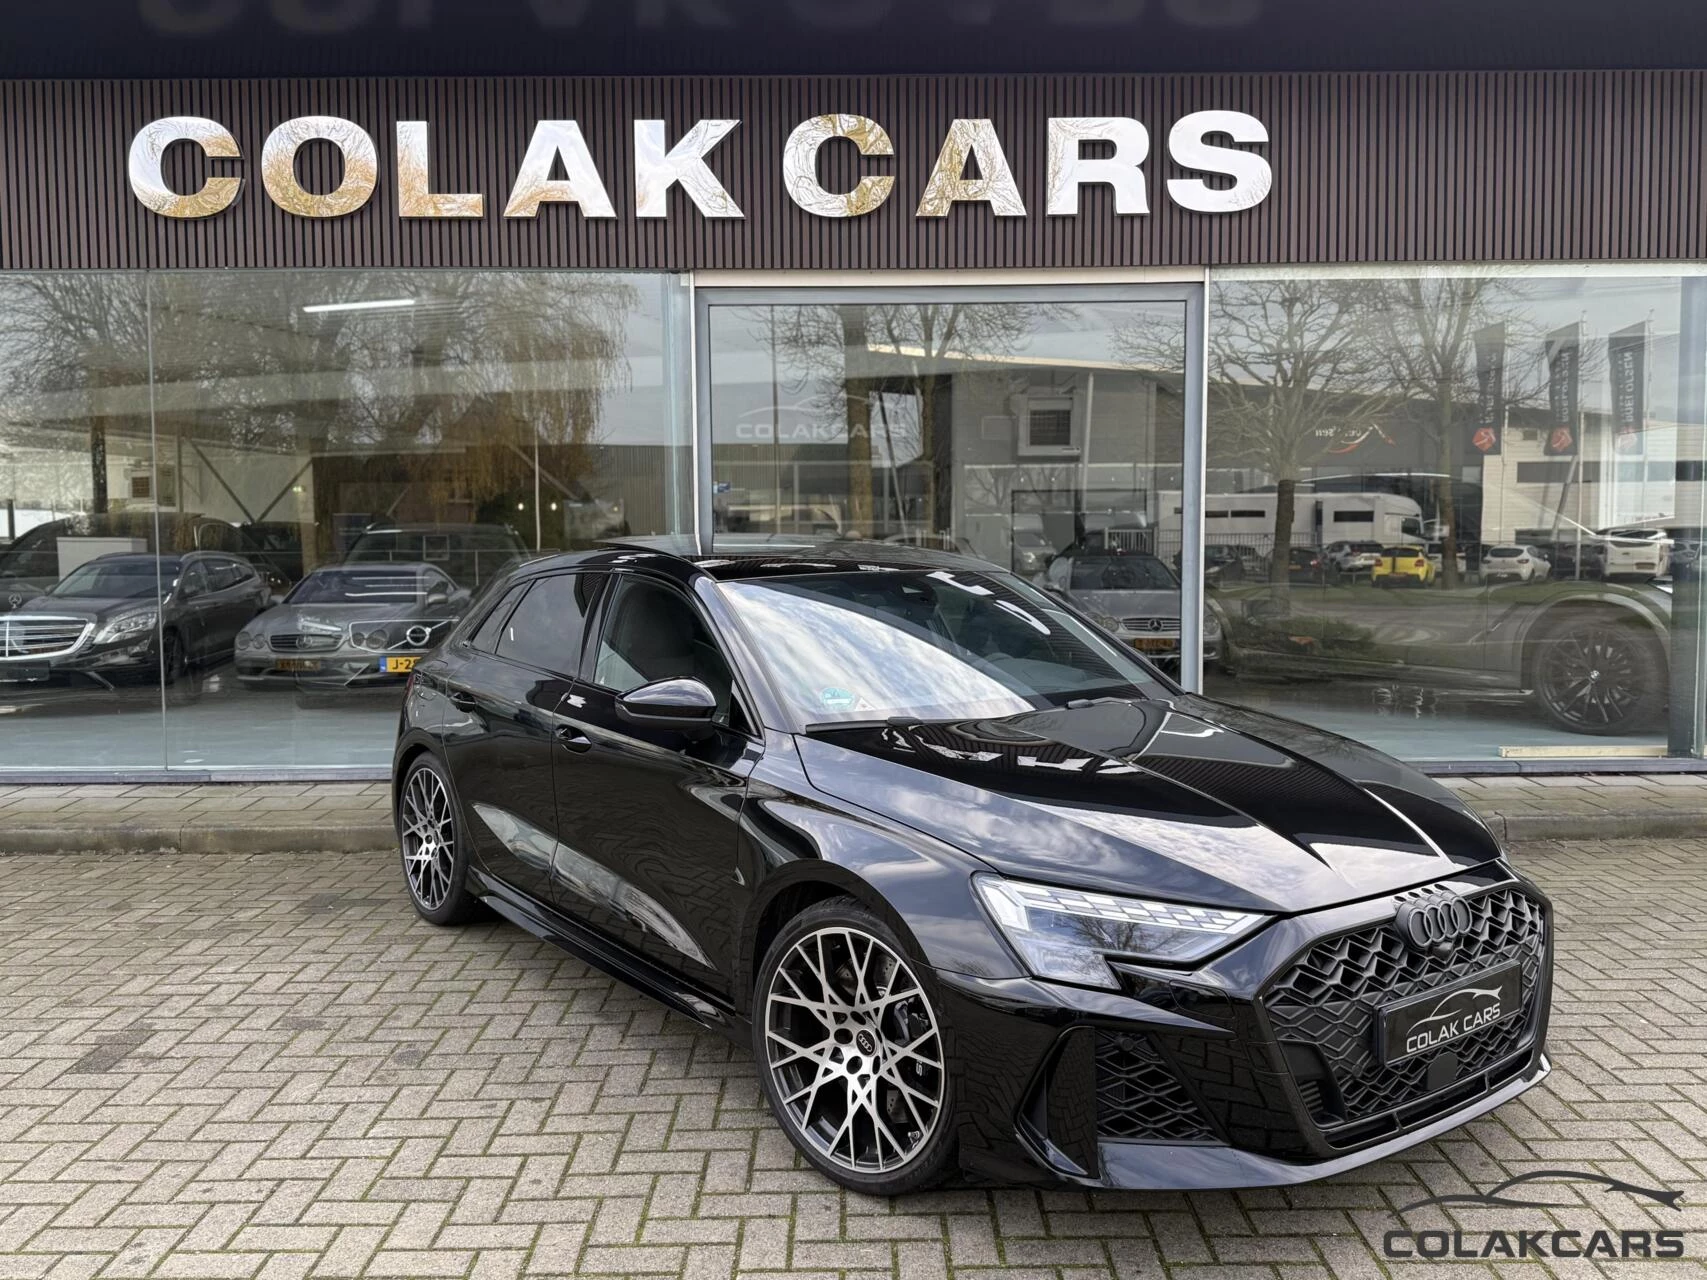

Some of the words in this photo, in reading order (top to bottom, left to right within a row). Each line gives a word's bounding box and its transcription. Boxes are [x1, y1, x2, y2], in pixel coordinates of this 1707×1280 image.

[128, 116, 746, 219] COLAK
[783, 110, 1274, 219] CARS
[1406, 1020, 1459, 1053] COLAK
[1463, 1003, 1500, 1031] CARS
